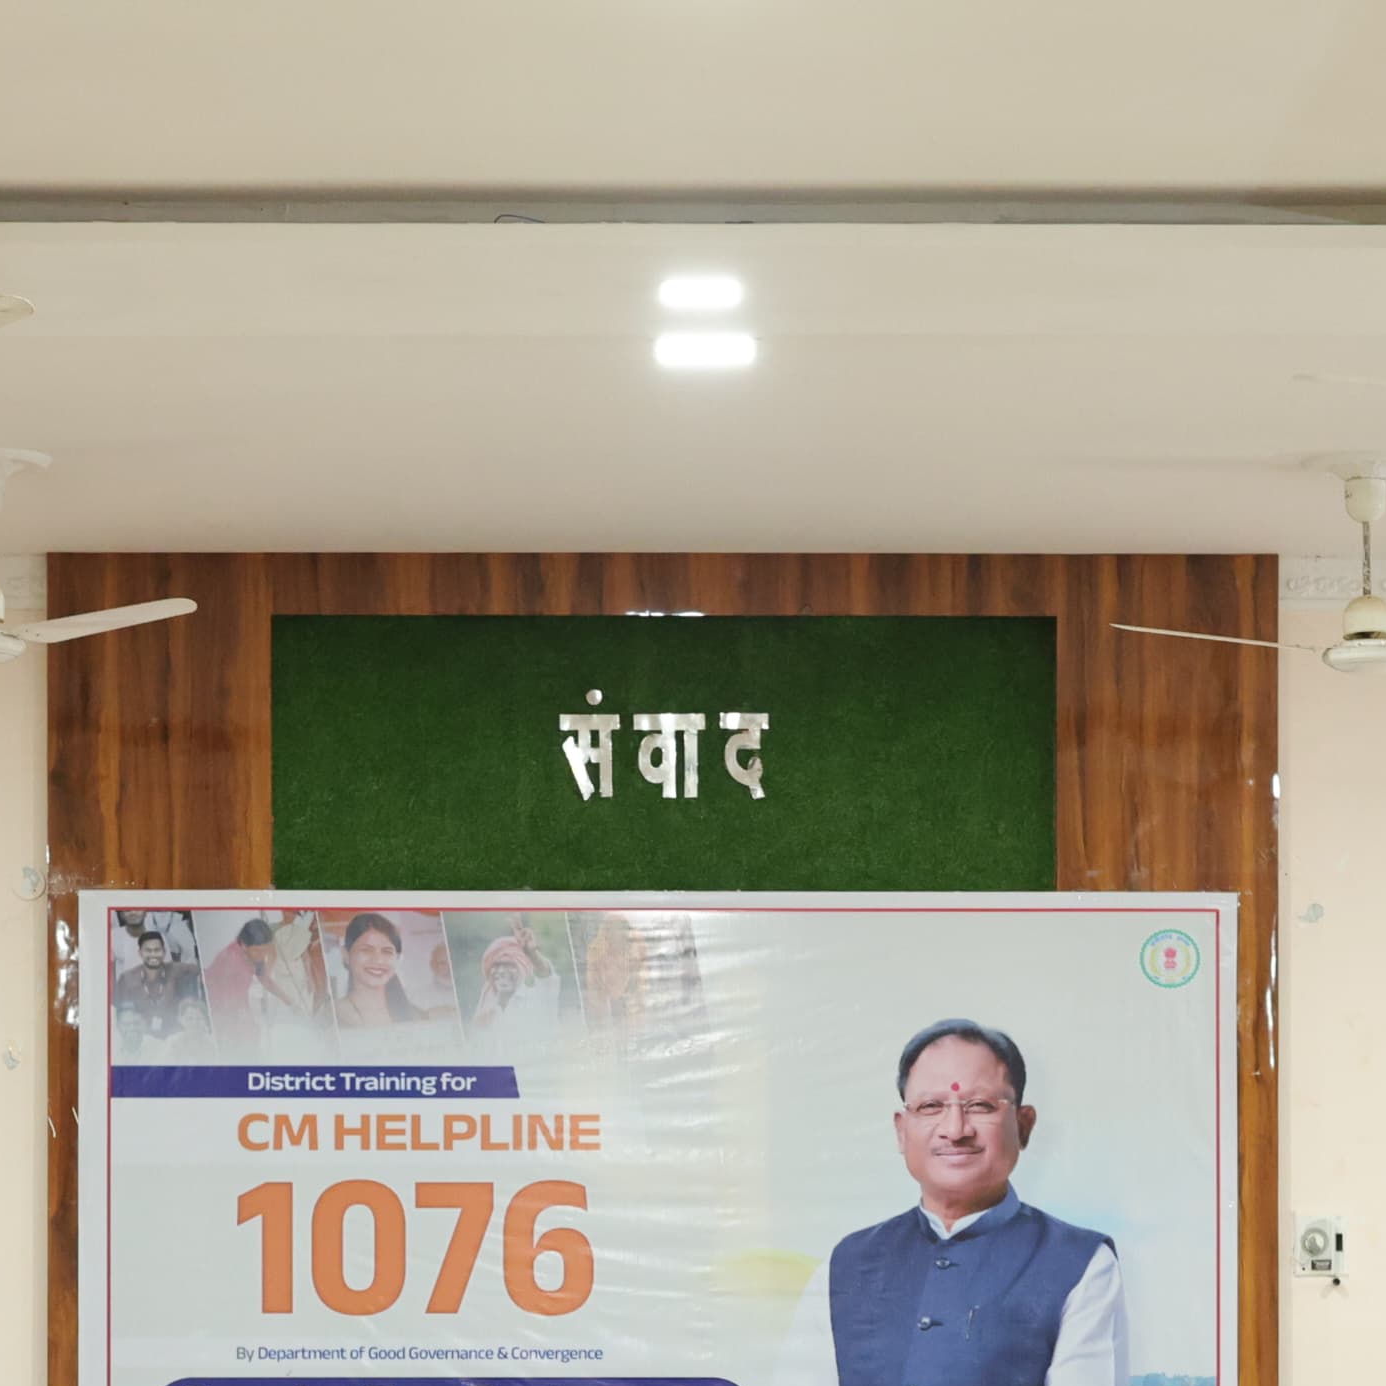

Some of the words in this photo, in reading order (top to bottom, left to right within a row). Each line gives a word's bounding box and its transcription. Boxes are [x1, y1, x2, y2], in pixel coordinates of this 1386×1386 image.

[559, 689, 769, 801] संवाद
[248, 1071, 334, 1093] District
[340, 1071, 437, 1097] Training
[439, 1071, 477, 1093] for
[237, 1113, 319, 1151] CM
[334, 1114, 601, 1151] HELPLINE
[237, 1179, 594, 1316] 1076
[236, 1347, 255, 1363] By
[258, 1346, 347, 1363] Department
[350, 1346, 366, 1360] of
[368, 1346, 406, 1360] Good
[409, 1346, 494, 1360] Governance
[497, 1347, 509, 1360] &
[512, 1346, 603, 1363] Convergence
